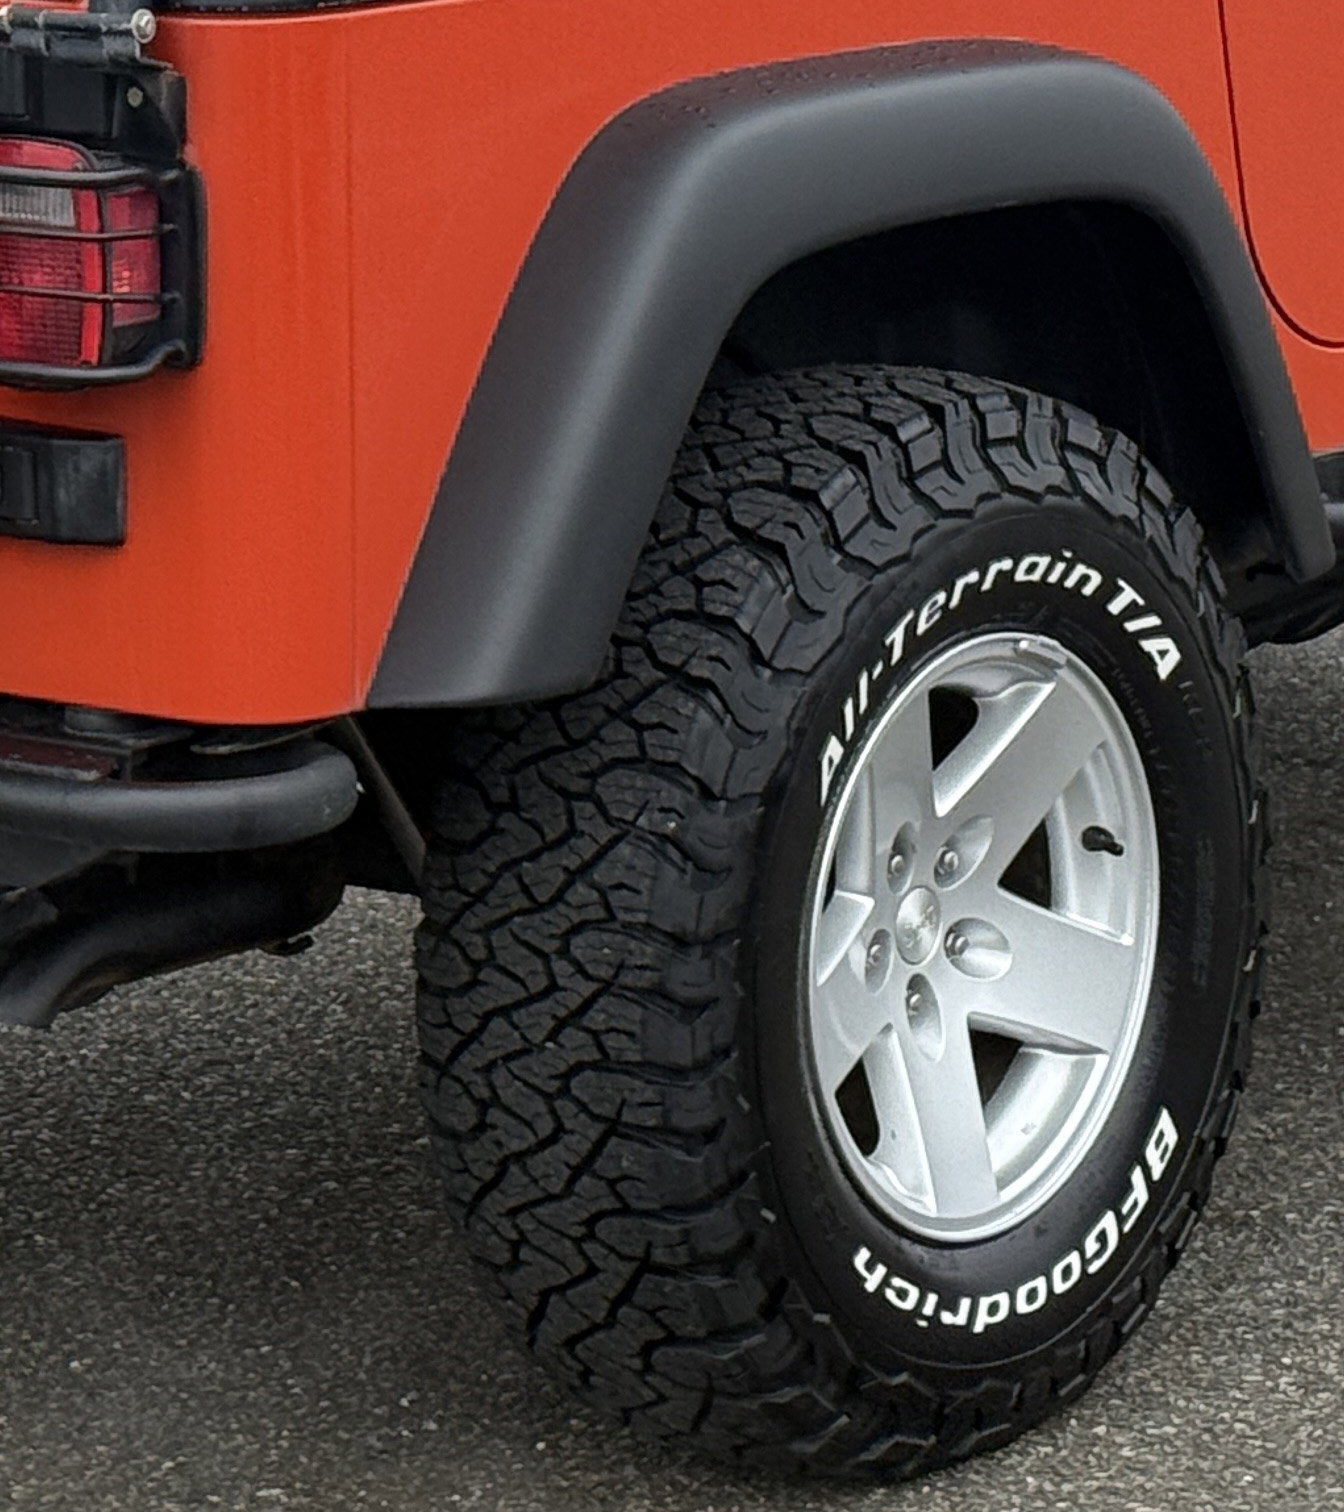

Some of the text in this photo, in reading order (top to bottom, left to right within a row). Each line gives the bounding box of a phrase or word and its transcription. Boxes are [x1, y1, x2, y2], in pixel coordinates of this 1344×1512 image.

[820, 549, 1103, 808] All-Terrain
[1106, 578, 1182, 681] T/A
[853, 1104, 1179, 1335] BFGoodrich
